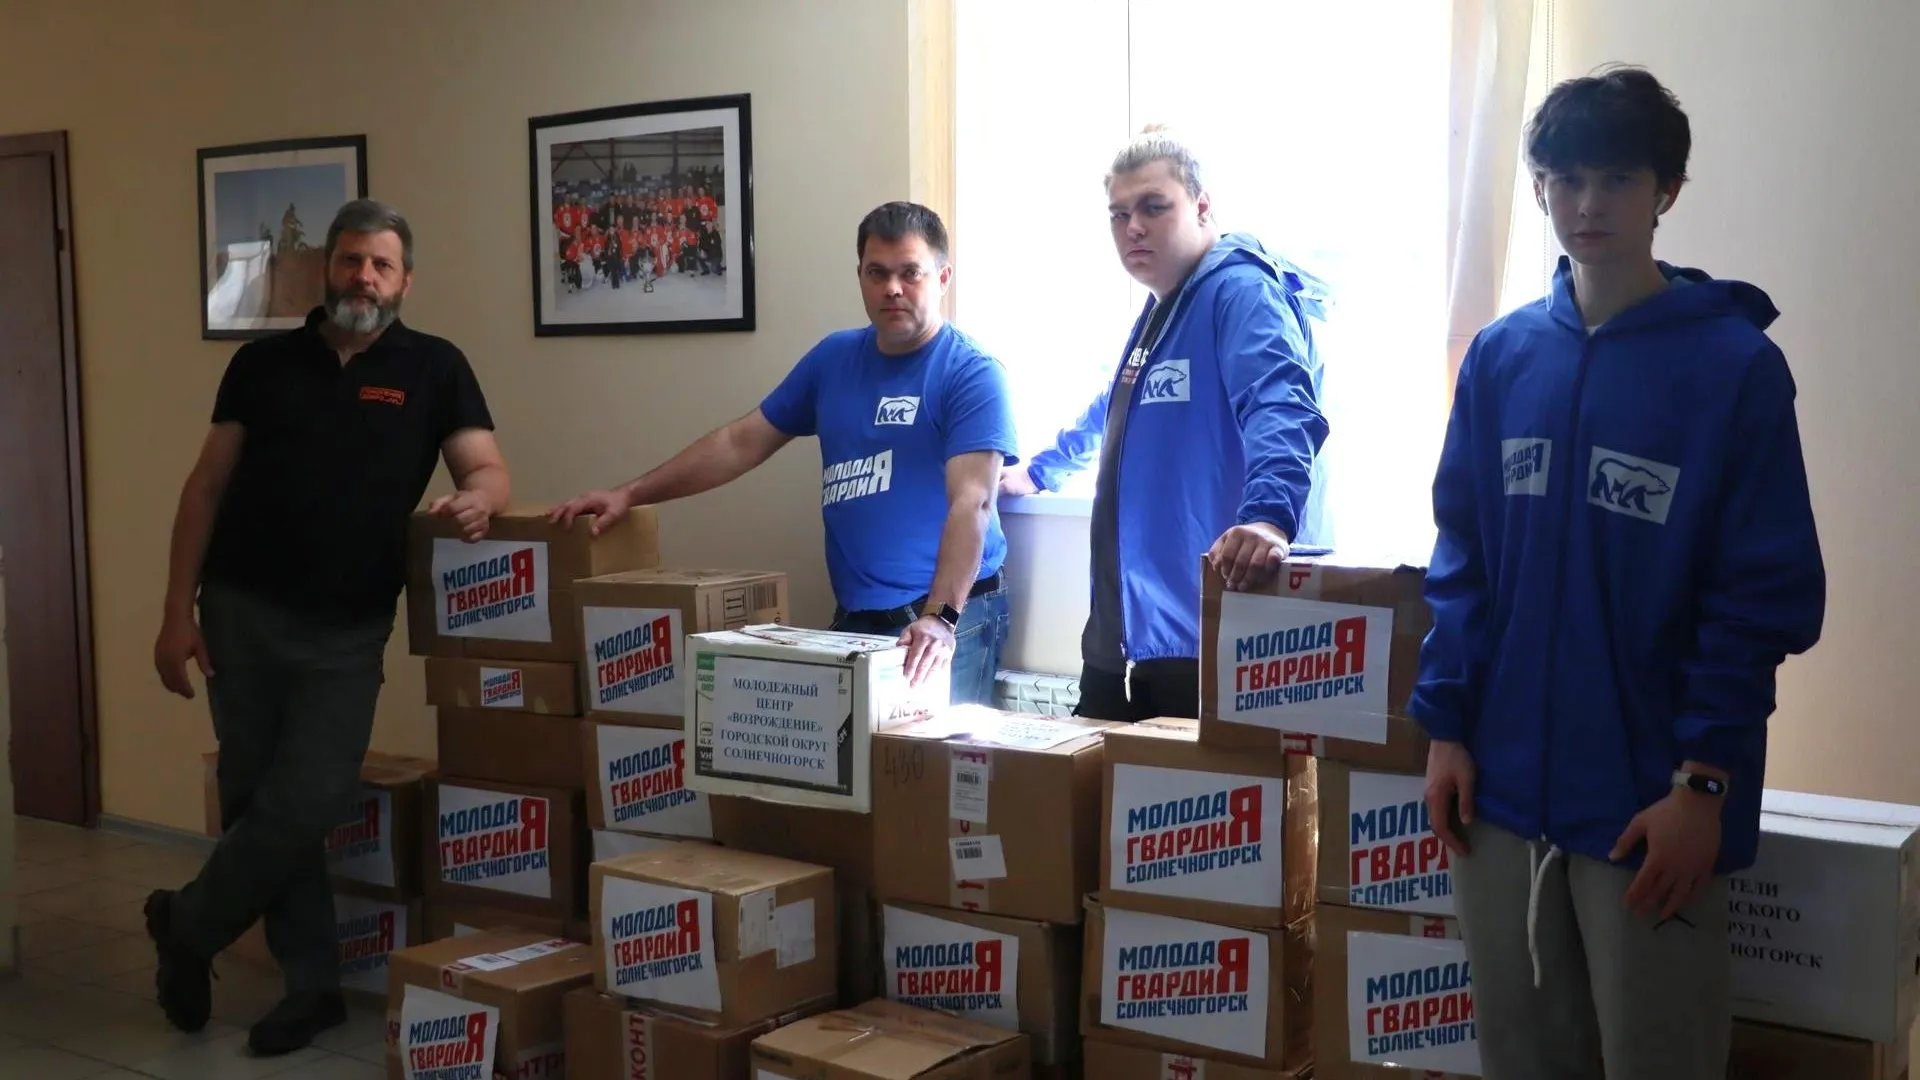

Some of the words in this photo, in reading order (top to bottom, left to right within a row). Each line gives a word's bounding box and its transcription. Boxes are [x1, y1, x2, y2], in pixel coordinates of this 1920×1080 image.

[447, 594, 536, 630] СОЛНЕЧНОГОРСК
[599, 665, 675, 704] СОЛНЕЧНОГОРСК
[733, 677, 819, 698] МОЛОДЕЖНЫЙ
[1235, 675, 1364, 712] СОЛНЕЧНОГОРСК
[756, 697, 794, 712] ЦЕНТР
[727, 712, 823, 733] «ВОЗРОЖДЕНИЕ»
[721, 729, 789, 747] ГОРОДСКОЙ
[792, 738, 829, 753] ОКРУГ
[724, 746, 825, 770] СОЛНЕЧНОГОРСК
[443, 855, 548, 881] СОЛНЕЧНОГОРСК
[1126, 844, 1262, 884] СОЛНЕЧНОГОРСК
[1729, 878, 1778, 898] ТЕЛИ
[1729, 900, 1800, 922] СКОГО
[1728, 920, 1772, 940] РУГА
[1730, 943, 1823, 969] НОГОРСК
[616, 953, 703, 986] СОЛНЕЧНОГОРСК
[1366, 961, 1473, 1003] МОЛОДА
[1117, 995, 1248, 1019] СОЛНЕЧНОГОРСК
[1367, 993, 1474, 1036] ГВАРДИ
[1368, 1023, 1477, 1056] СОЛНЕЧНОГ
